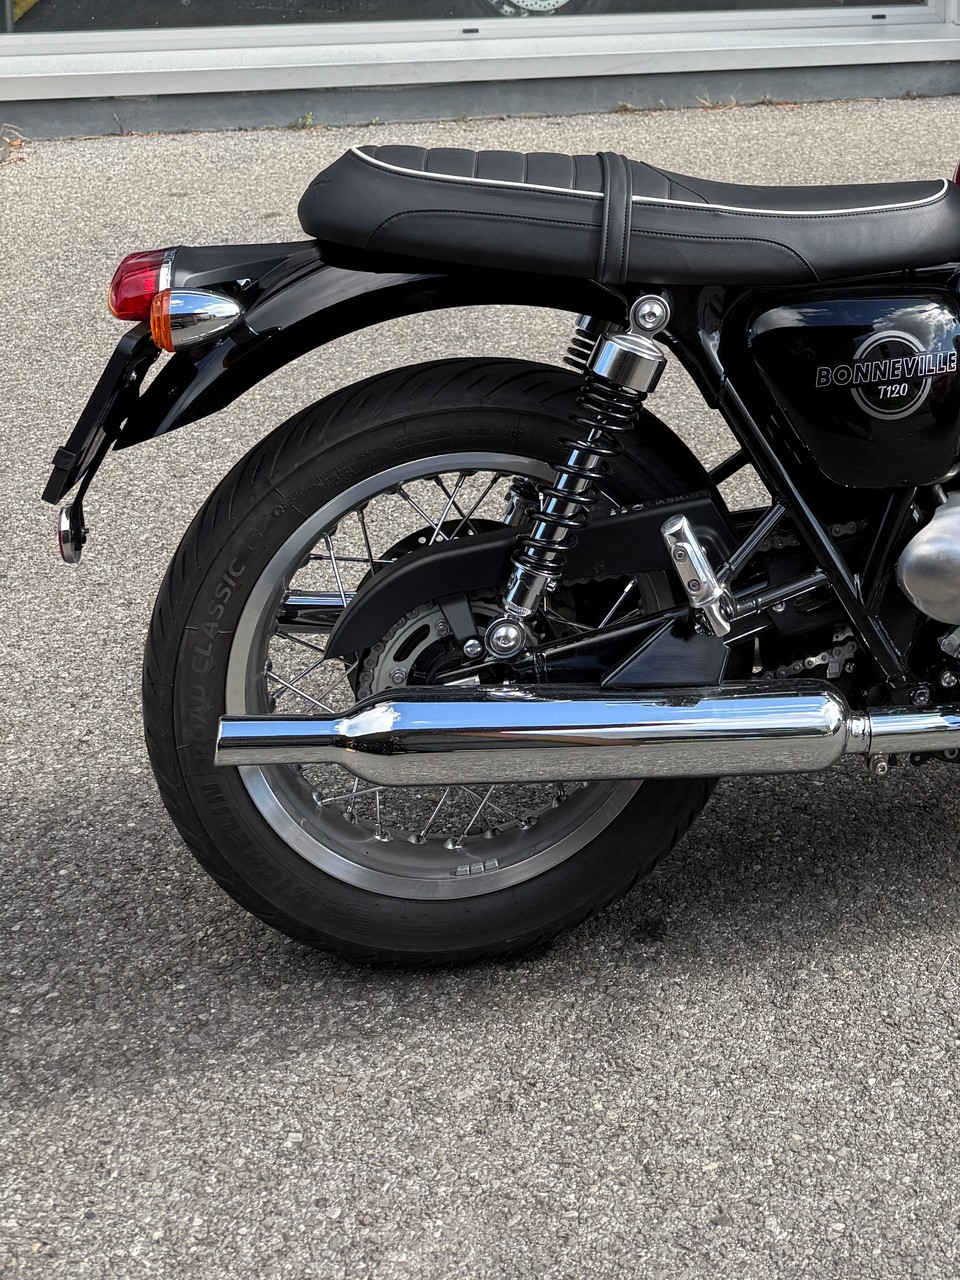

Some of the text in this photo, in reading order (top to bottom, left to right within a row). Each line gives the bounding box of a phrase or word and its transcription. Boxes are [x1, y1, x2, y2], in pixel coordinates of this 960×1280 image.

[815, 351, 957, 387] BONNEVILLE
[878, 383, 908, 399] T120
[192, 556, 245, 674] CLASSIC
